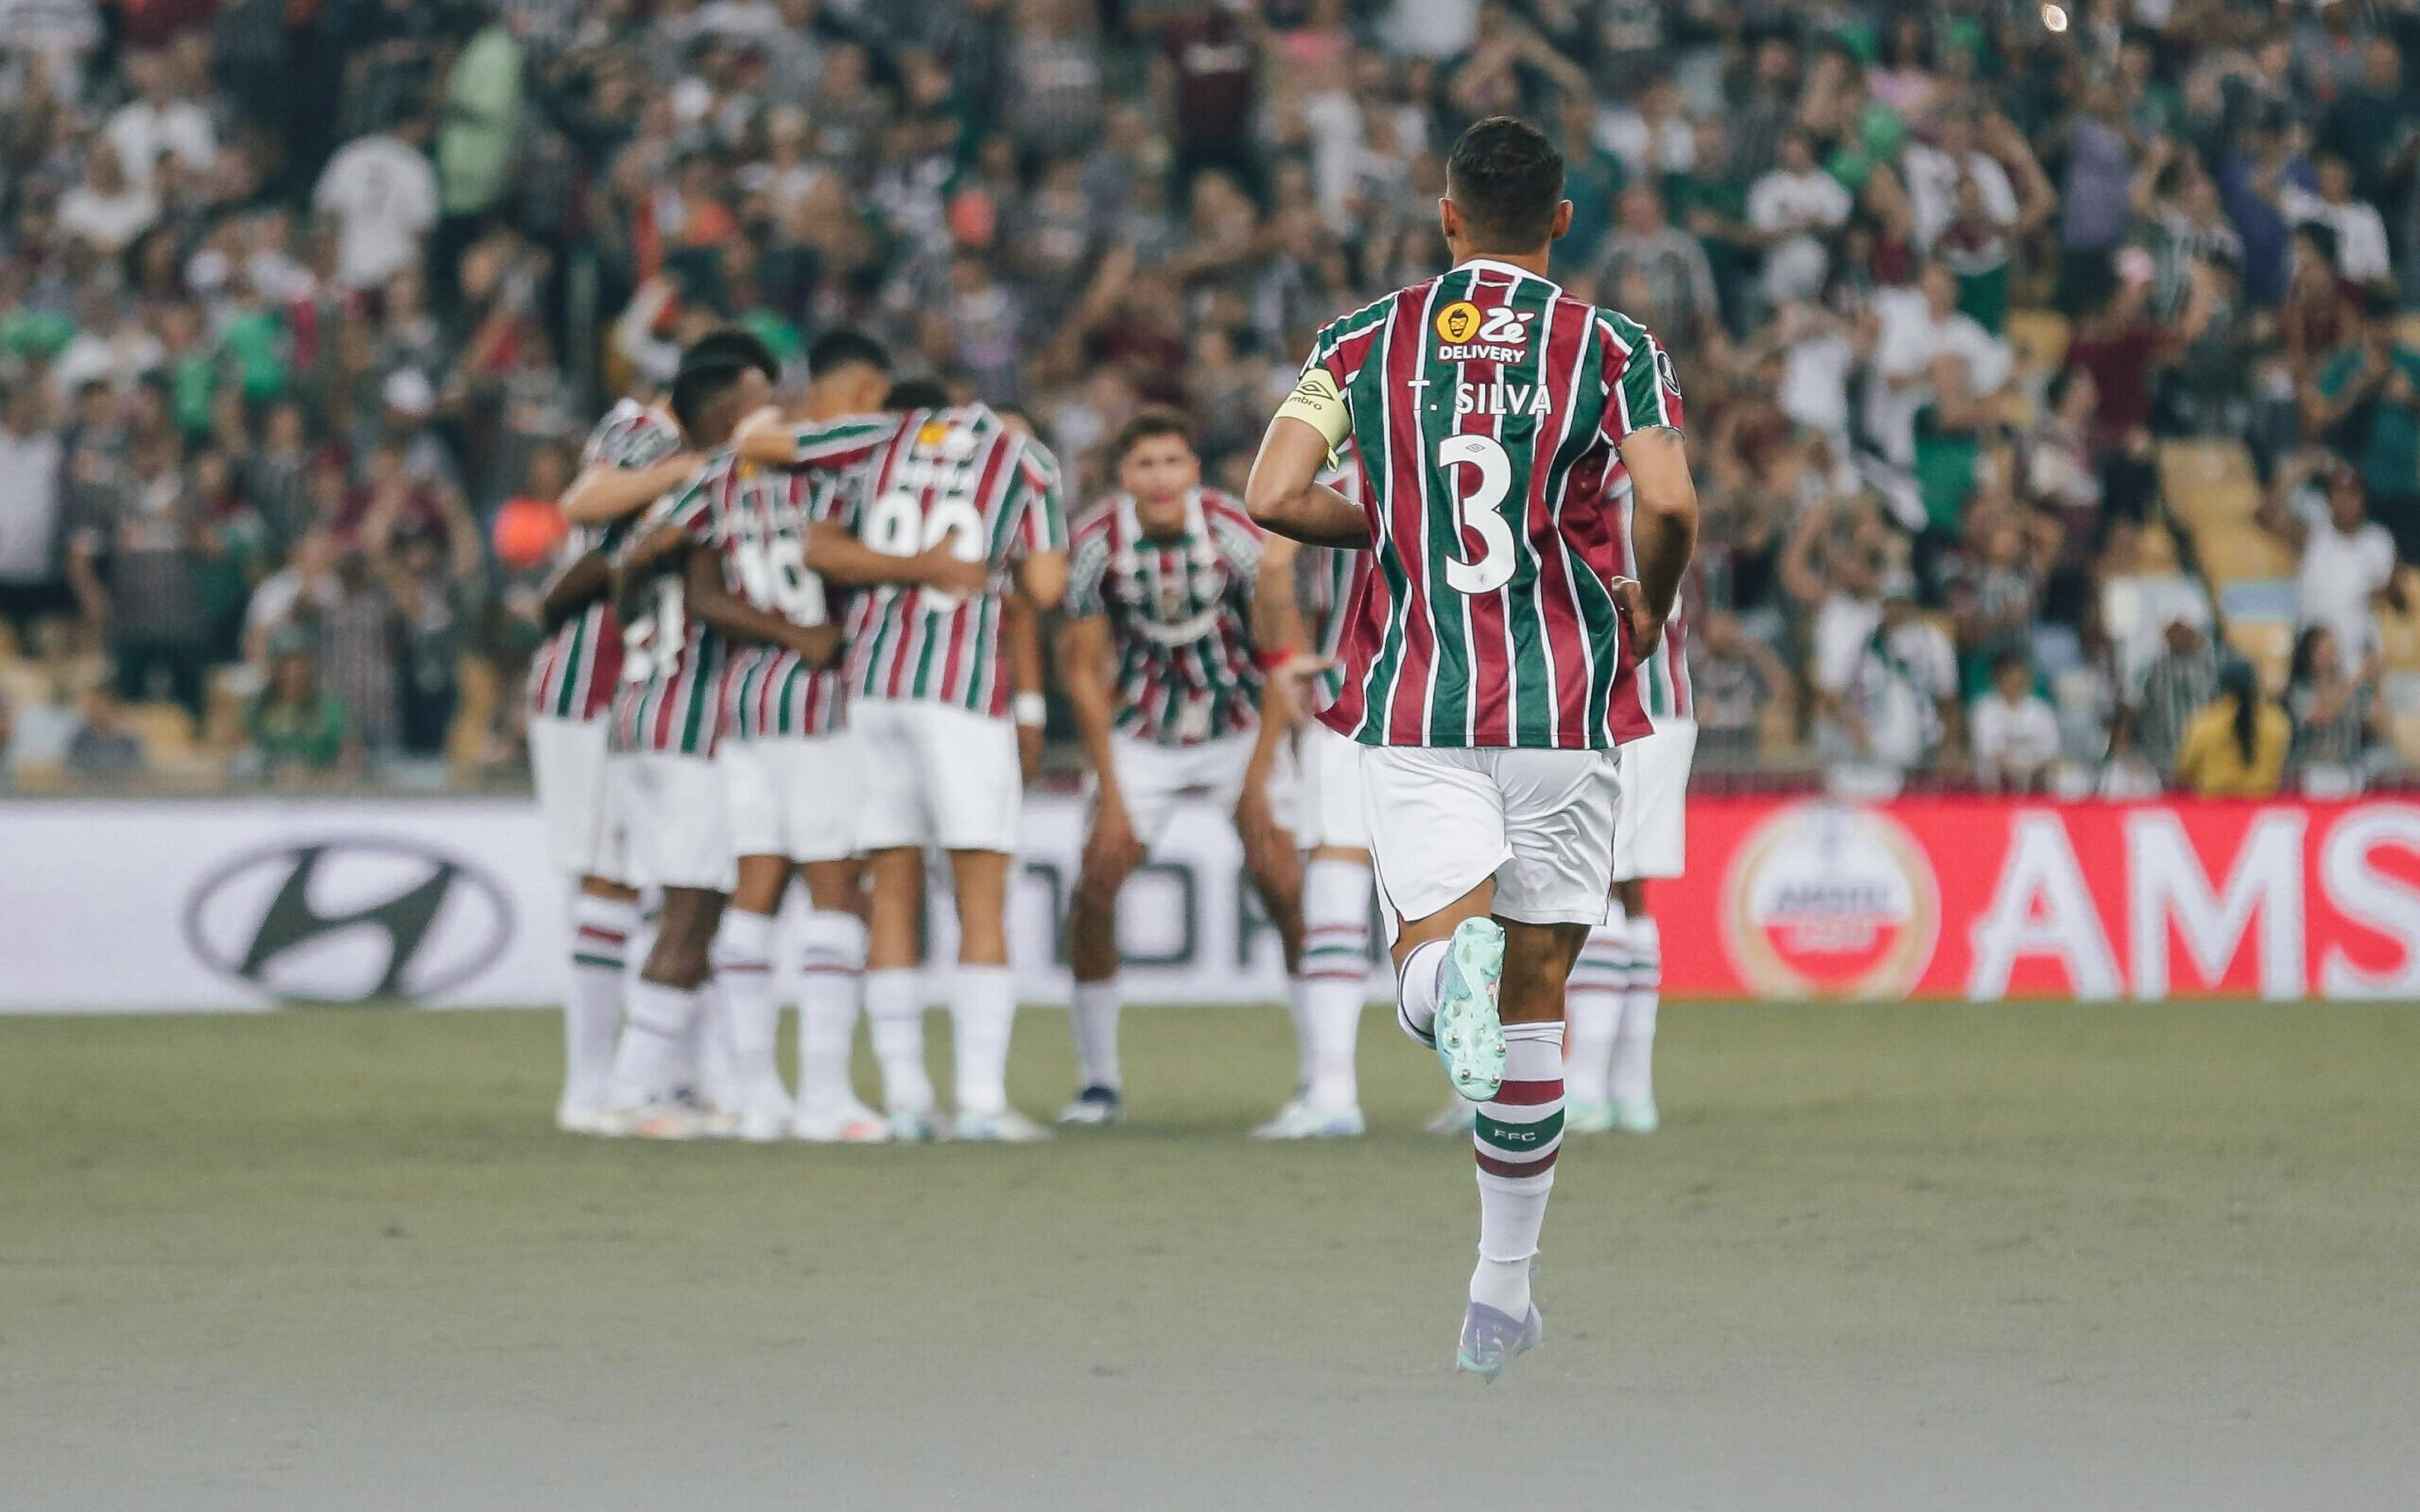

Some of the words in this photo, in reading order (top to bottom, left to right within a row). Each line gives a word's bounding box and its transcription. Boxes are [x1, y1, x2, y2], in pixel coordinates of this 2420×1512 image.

[1479, 307, 1535, 344] Zé
[1439, 345, 1526, 364] DELIVERY
[1288, 396, 1322, 411] mbro
[1407, 380, 1438, 411] T.
[1456, 382, 1552, 415] SILVA
[1439, 434, 1516, 593] 3
[1494, 1129, 1536, 1142] FFC
